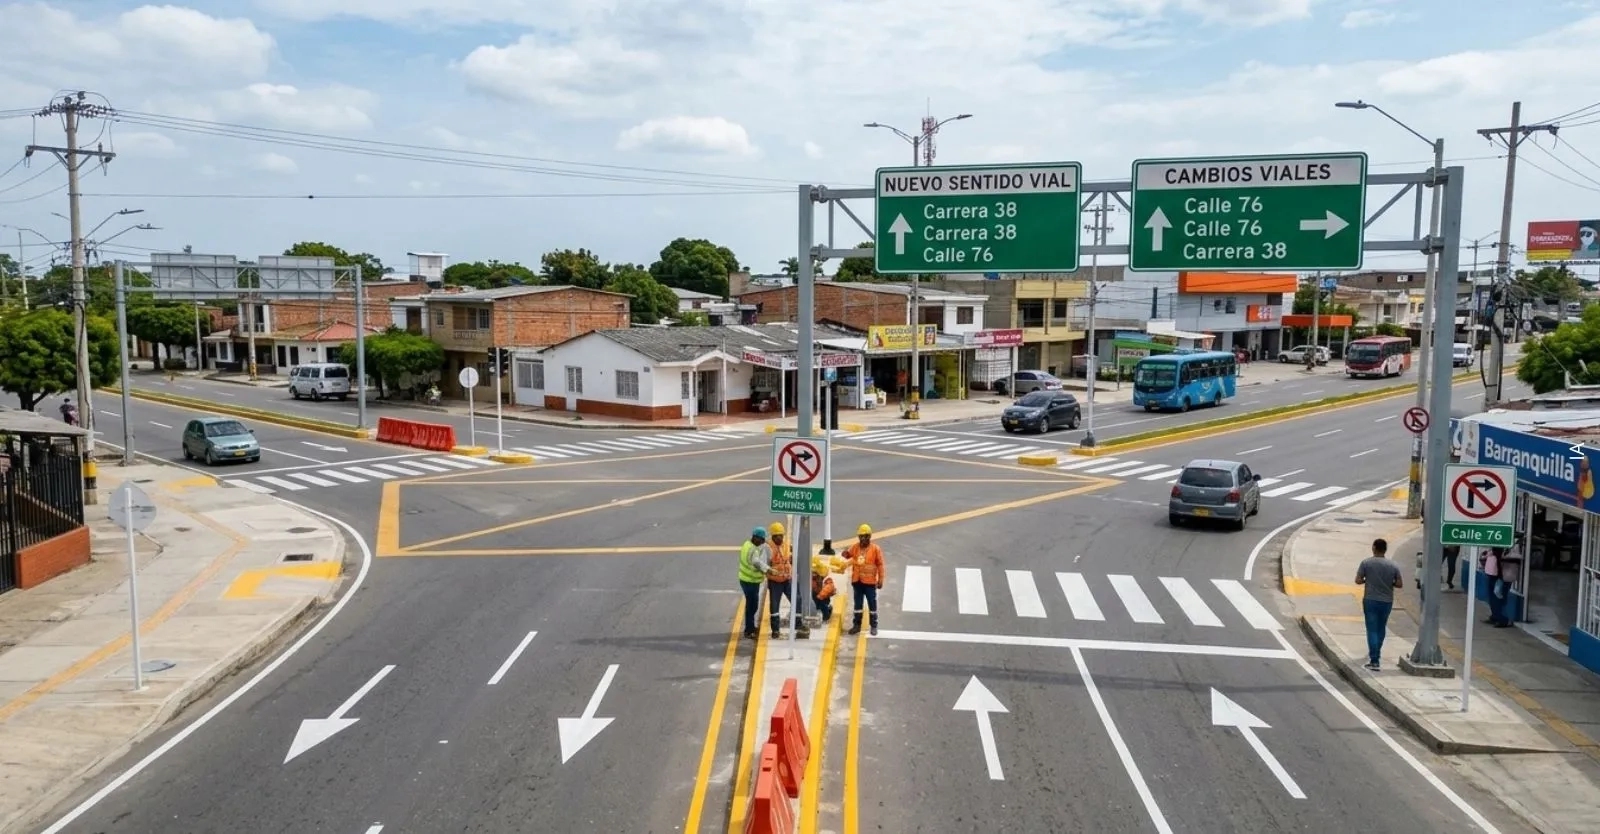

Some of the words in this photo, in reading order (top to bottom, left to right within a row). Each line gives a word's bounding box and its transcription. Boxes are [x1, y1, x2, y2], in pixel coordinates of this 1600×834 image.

[885, 175, 943, 192] NUEVO
[949, 173, 1024, 191] SENTIDO
[1030, 172, 1071, 189] VIAL
[1165, 166, 1253, 184] CAMBIOS
[1260, 164, 1331, 182] VIALES
[924, 204, 988, 219] Carrera
[995, 202, 1017, 218] 38
[1184, 197, 1231, 213] Calle
[1239, 196, 1263, 212] 76
[924, 226, 988, 241] Carrera
[995, 224, 1017, 240] 38
[1184, 220, 1230, 236] Calle
[1238, 220, 1262, 236] 76
[923, 247, 965, 262] Calle
[971, 247, 993, 262] 76
[1184, 243, 1254, 259] Carrera
[1262, 242, 1287, 259] 38
[1484, 437, 1575, 482] Barranquilla
[1451, 528, 1482, 540] Calle
[1487, 530, 1503, 541] 76
